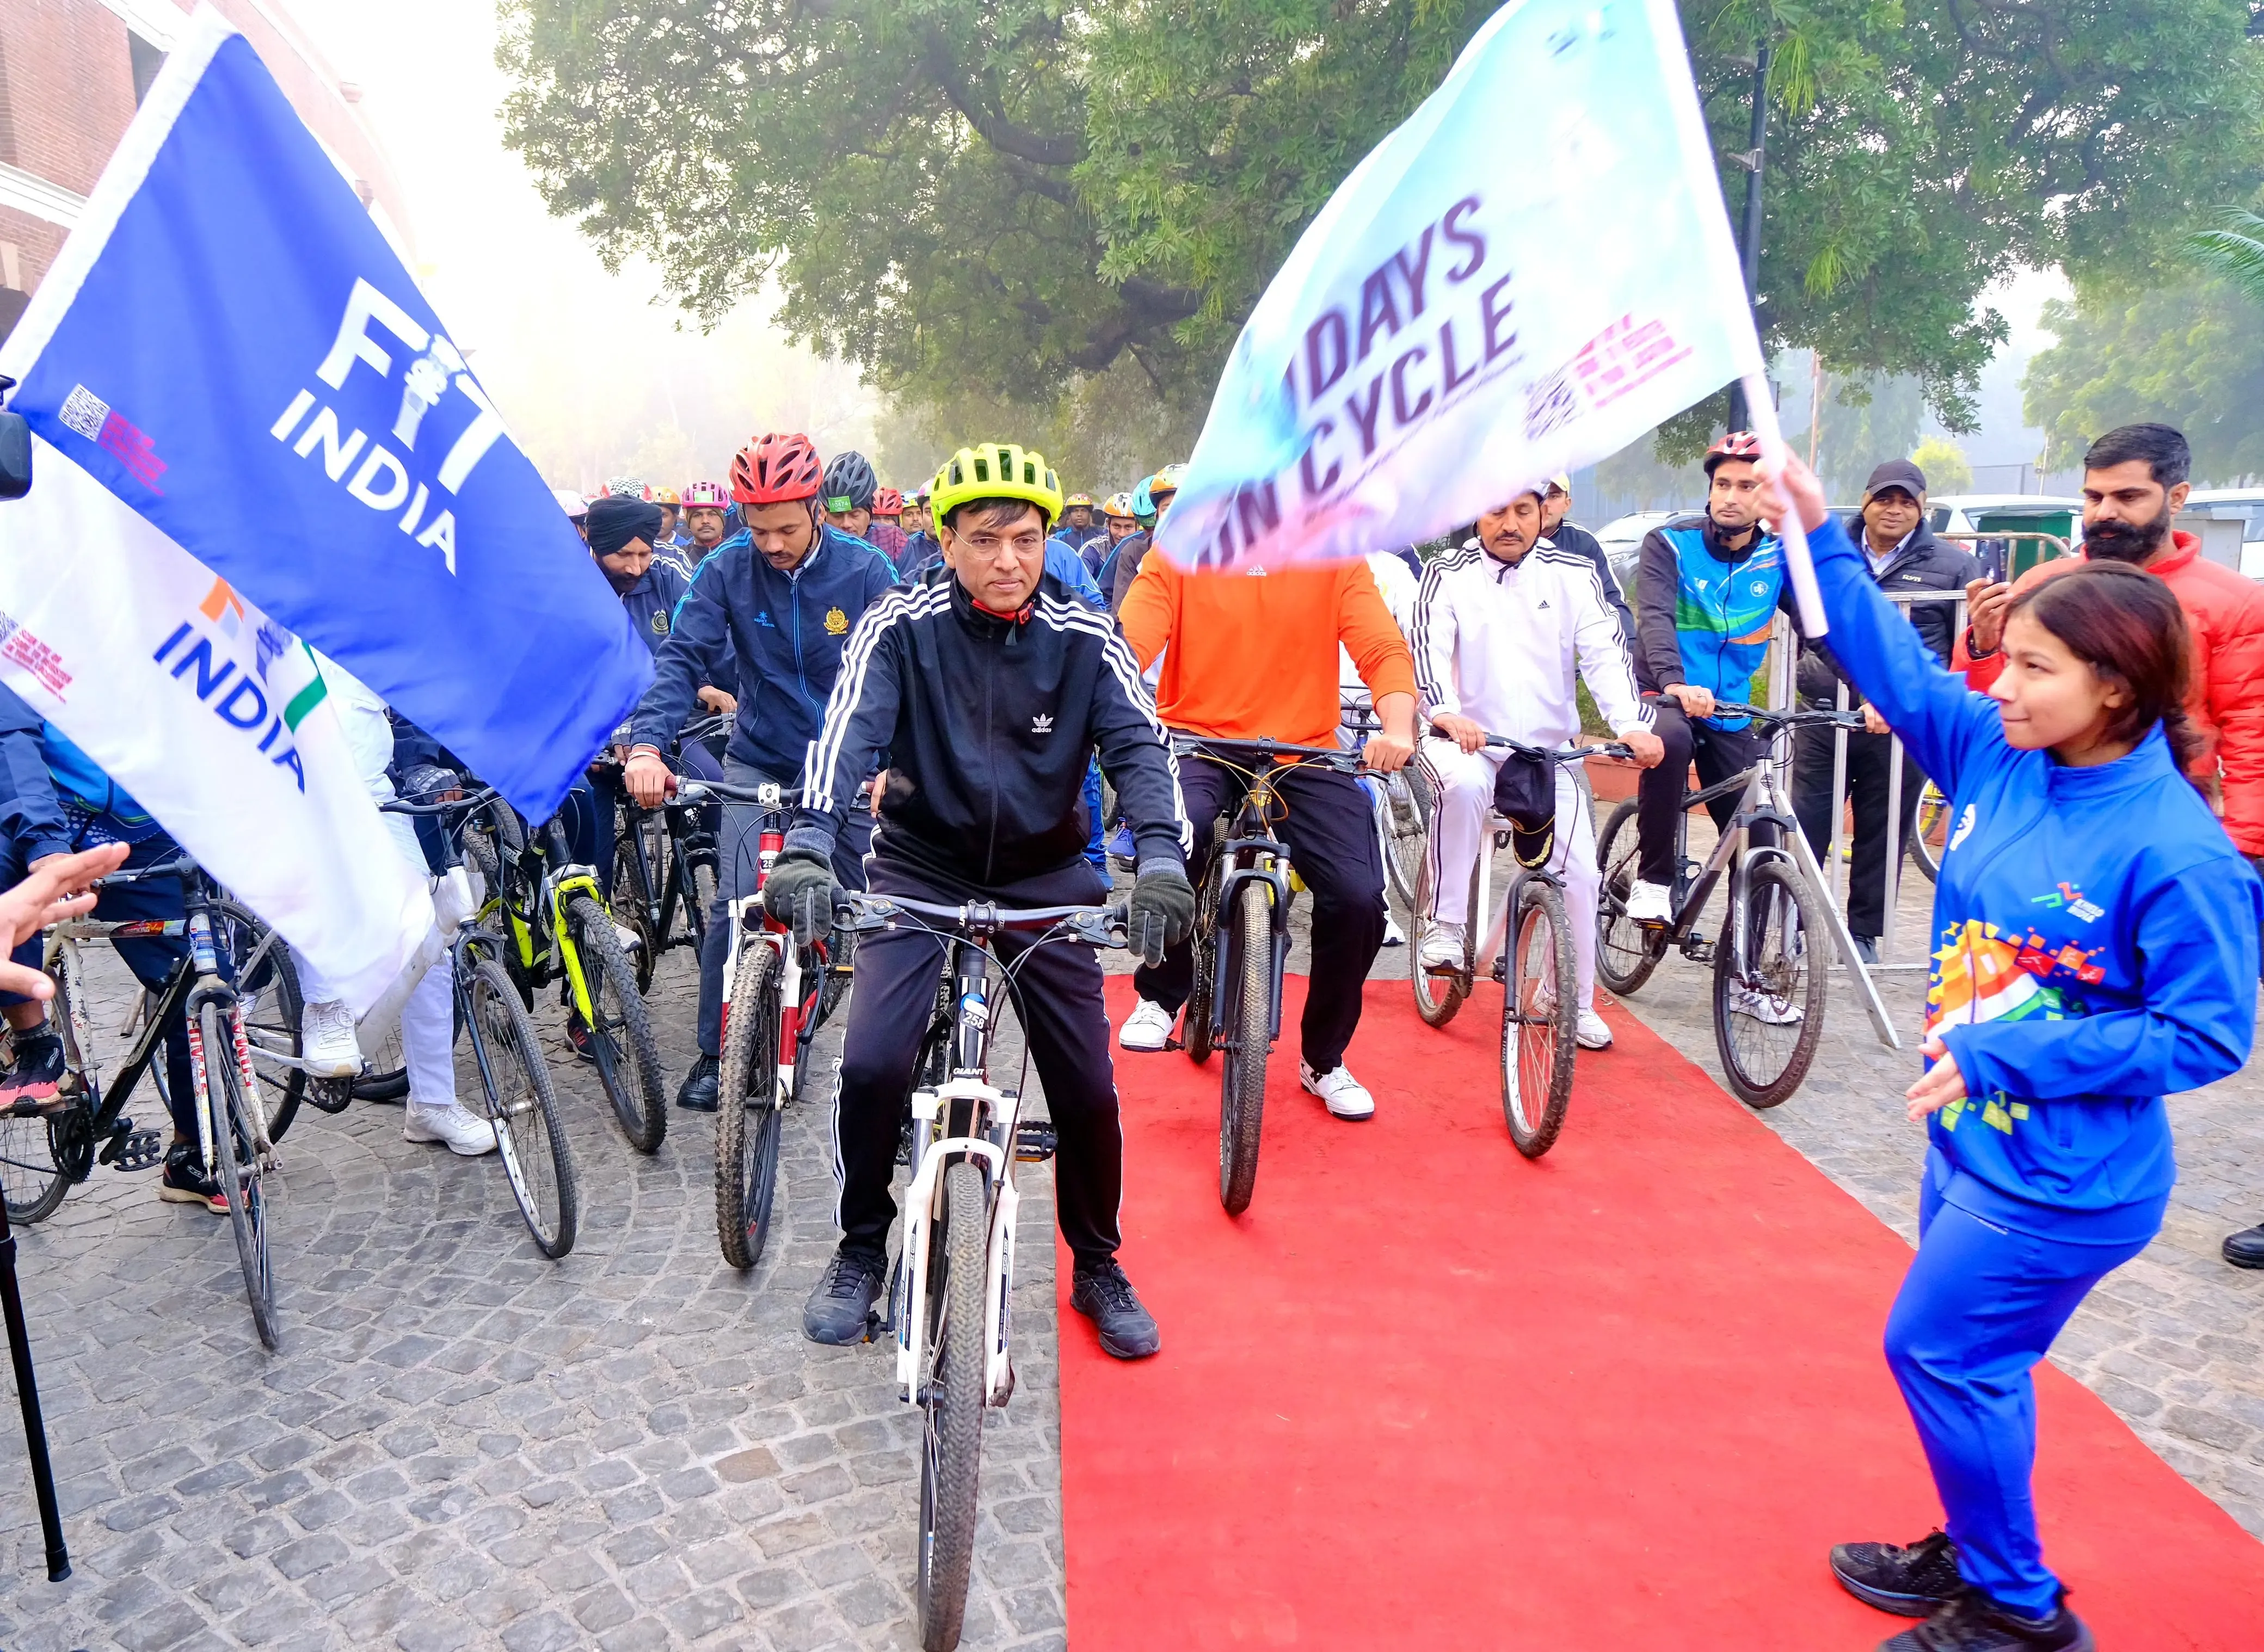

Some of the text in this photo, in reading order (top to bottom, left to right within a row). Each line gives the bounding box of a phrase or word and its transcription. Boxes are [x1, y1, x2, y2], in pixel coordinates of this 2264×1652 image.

[1283, 194, 1485, 407] DAYS
[270, 387, 456, 577] INDIA
[153, 620, 305, 794] INDIA
[963, 1012, 985, 1029] 258
